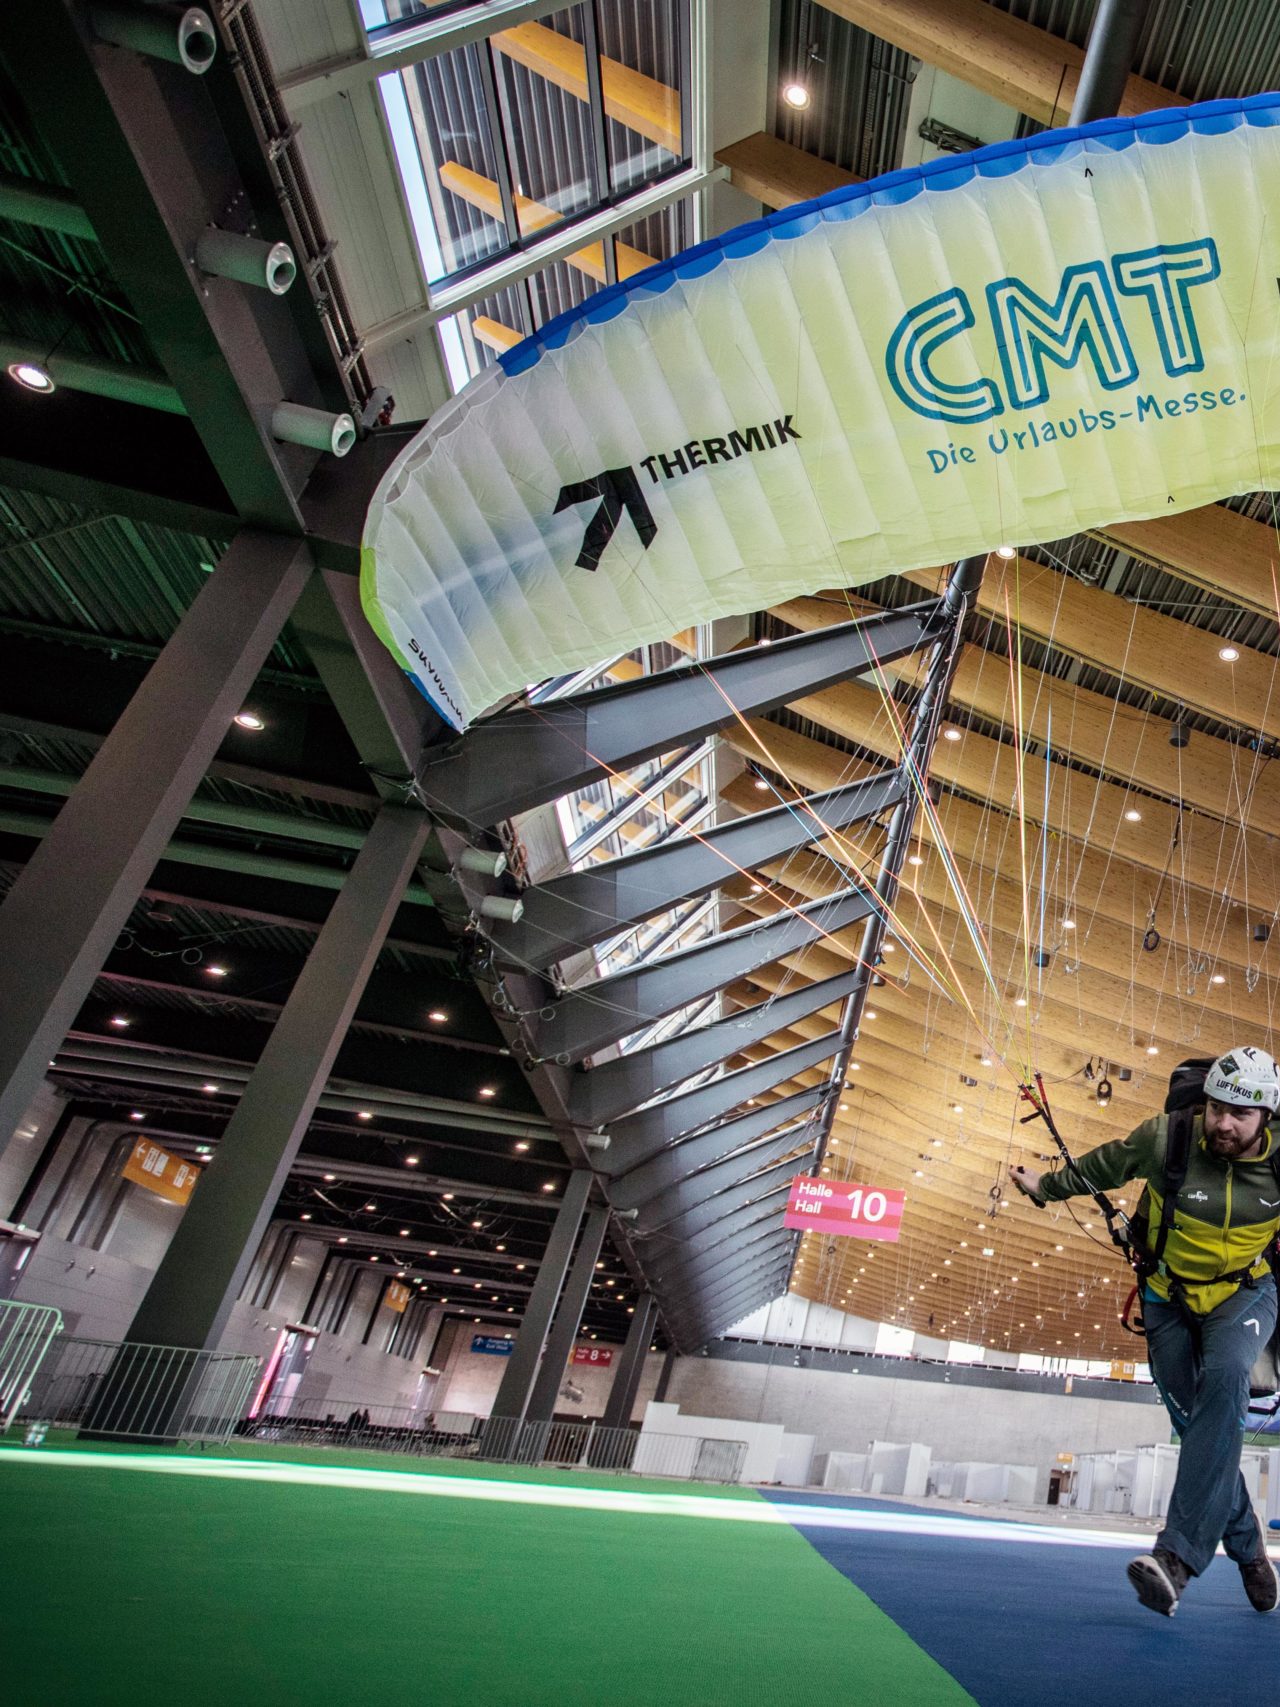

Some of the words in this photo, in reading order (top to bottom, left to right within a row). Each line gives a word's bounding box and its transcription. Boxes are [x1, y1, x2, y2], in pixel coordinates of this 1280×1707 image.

[885, 237, 1221, 424] CMT
[640, 415, 802, 484] THERMIK
[926, 443, 976, 474] Die
[988, 387, 1246, 454] Urlaubs-Messe.
[1216, 1079, 1252, 1099] LUFTIKUS
[795, 1199, 822, 1214] Hall
[799, 1182, 832, 1197] Halle
[847, 1189, 887, 1222] 10
[590, 1350, 599, 1361] 8
